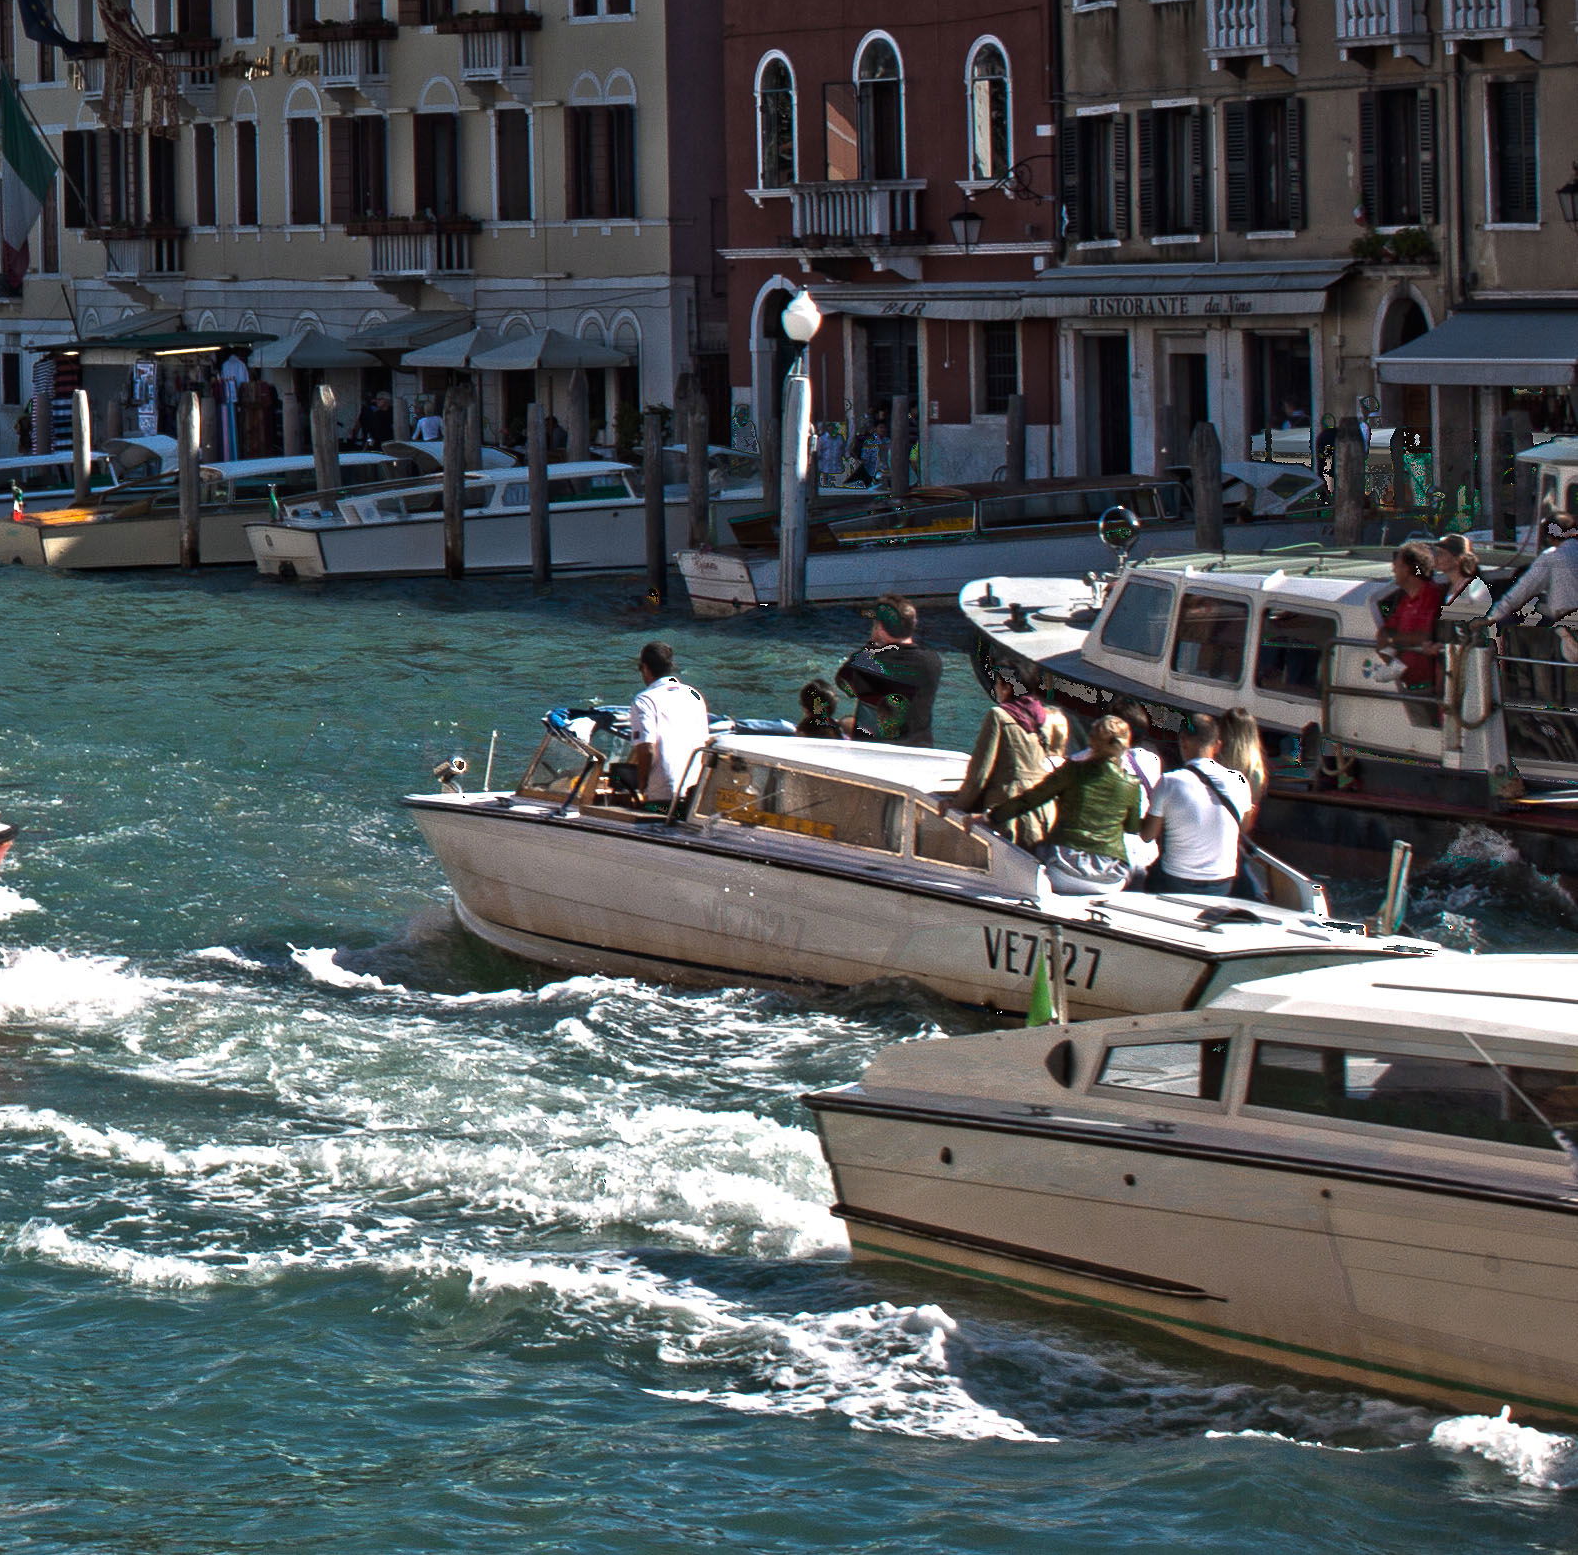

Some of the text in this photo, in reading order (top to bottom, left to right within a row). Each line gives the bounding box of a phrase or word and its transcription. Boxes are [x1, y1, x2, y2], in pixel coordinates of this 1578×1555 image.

[880, 301, 927, 316] BAR
[1089, 296, 1189, 316] RISTORANTE
[1204, 296, 1221, 314] da
